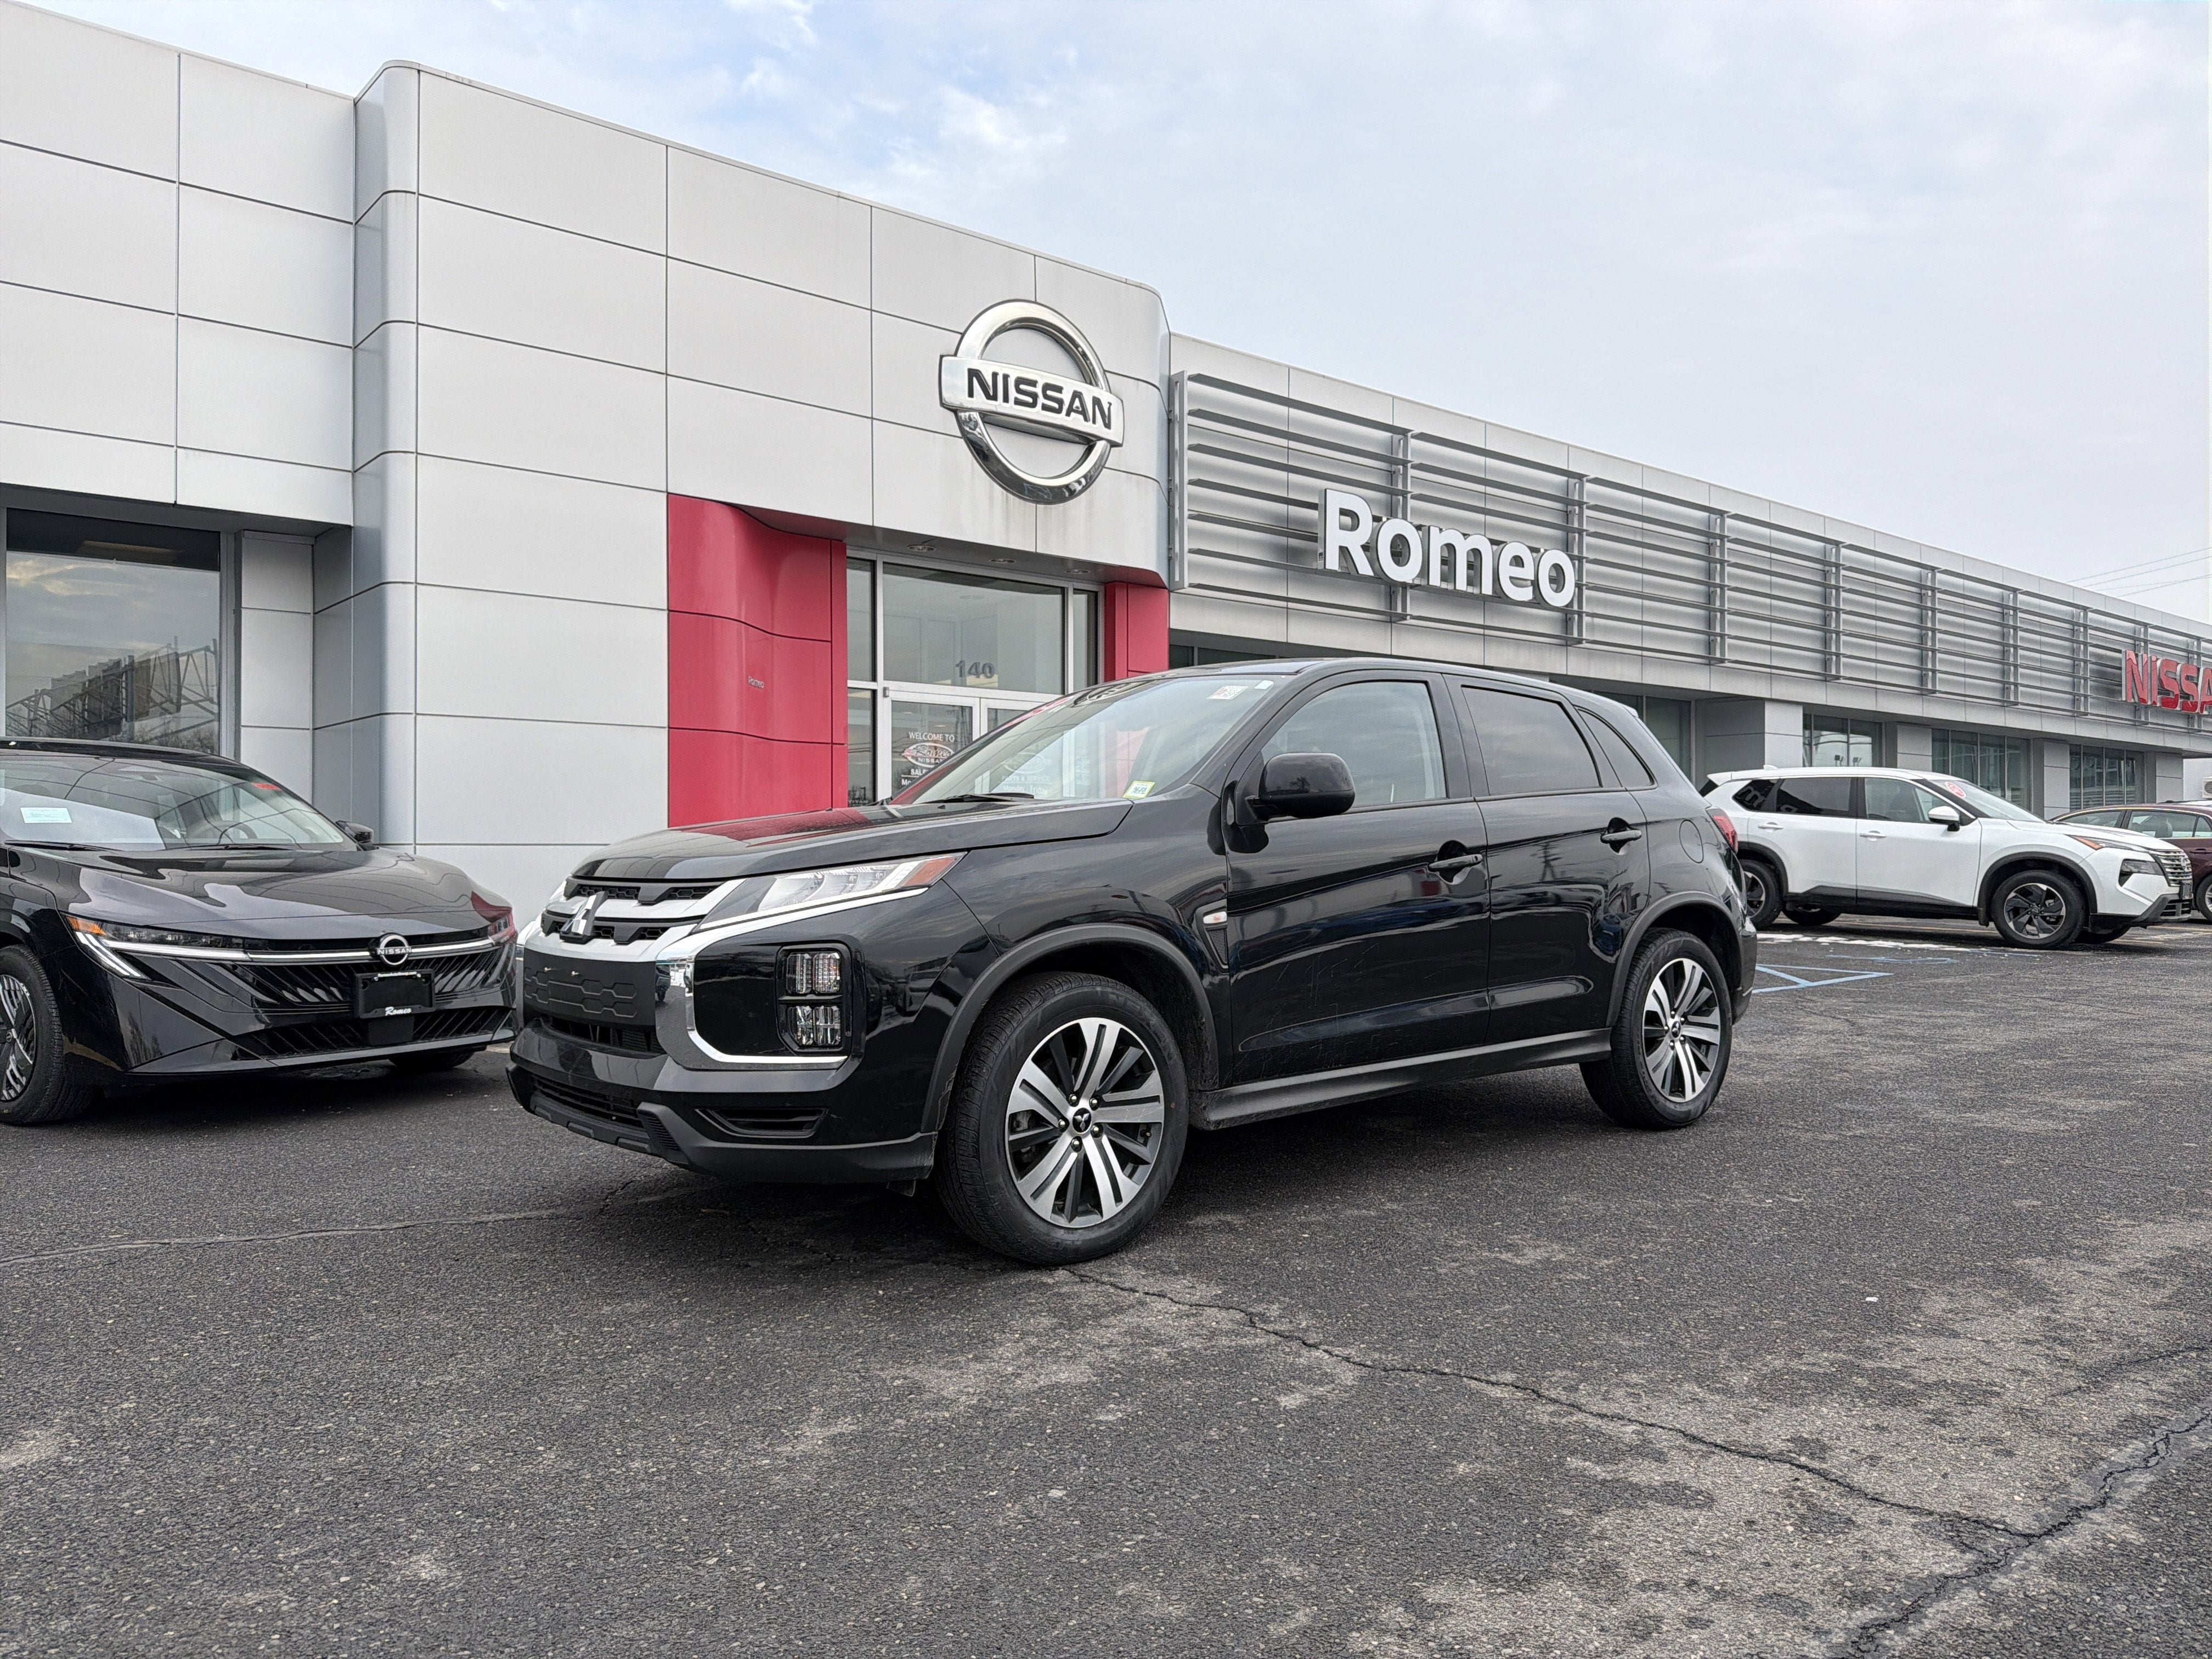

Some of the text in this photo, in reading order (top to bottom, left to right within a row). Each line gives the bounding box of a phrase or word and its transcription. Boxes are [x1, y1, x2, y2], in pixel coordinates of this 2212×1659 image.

[967, 368, 1112, 430] NISSAN
[1323, 488, 1576, 607] Romeo
[956, 660, 995, 679] 140
[909, 731, 955, 742] WELCOME TO
[385, 1006, 411, 1016] Romeo
